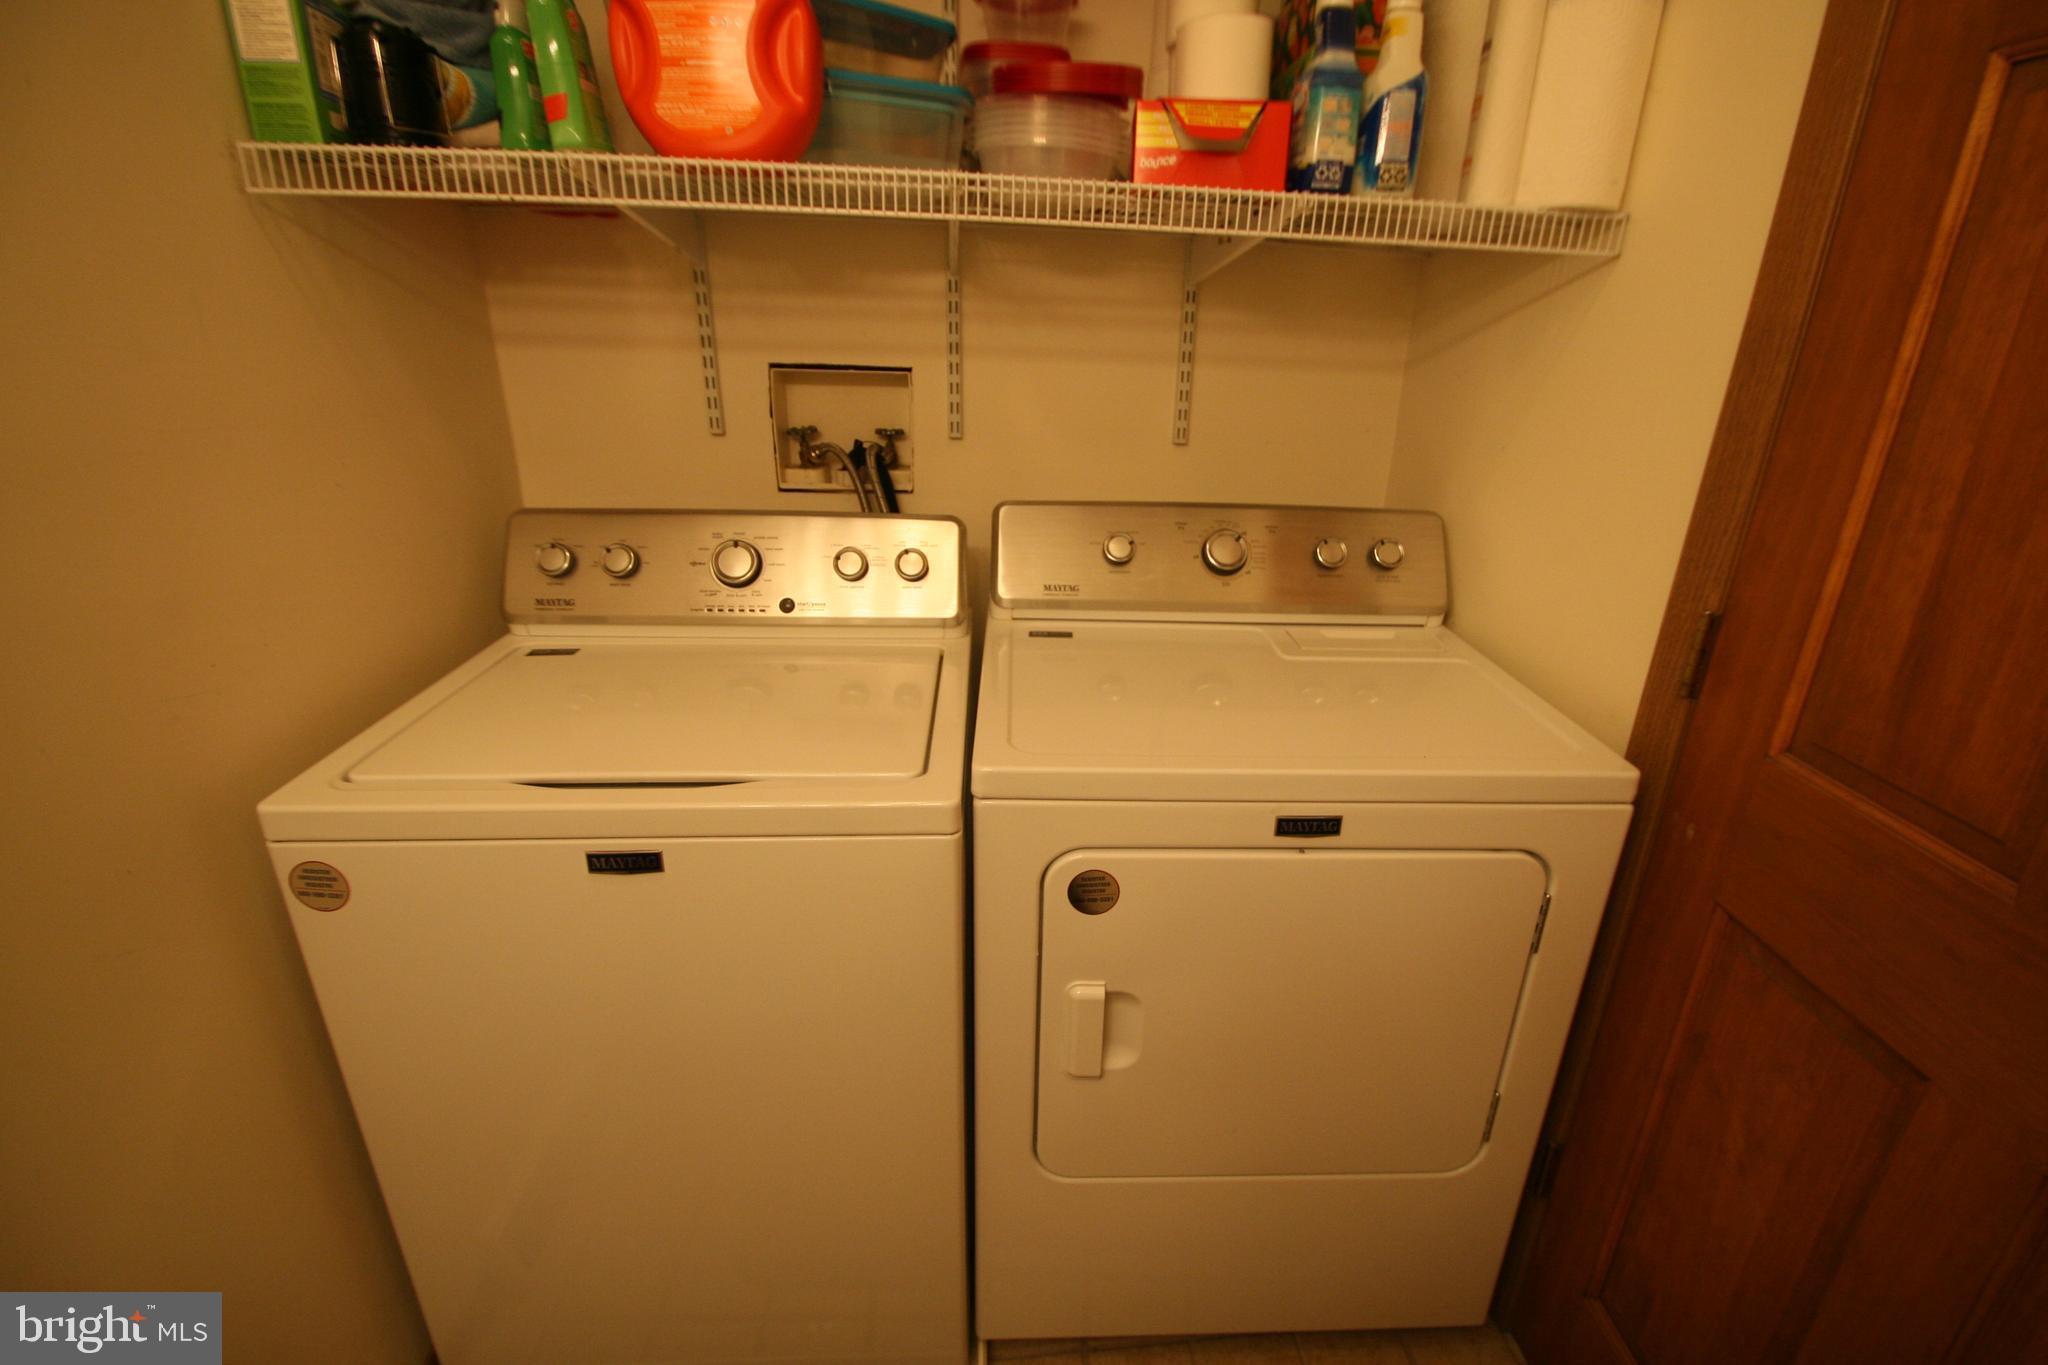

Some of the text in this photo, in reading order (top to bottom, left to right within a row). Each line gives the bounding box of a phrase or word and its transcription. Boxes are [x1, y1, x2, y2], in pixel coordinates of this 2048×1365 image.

[1043, 584, 1080, 592] MAYTAG
[535, 598, 575, 607] MAYTAG
[1280, 821, 1338, 833] MAYTAG
[591, 856, 657, 869] MAYTAG
